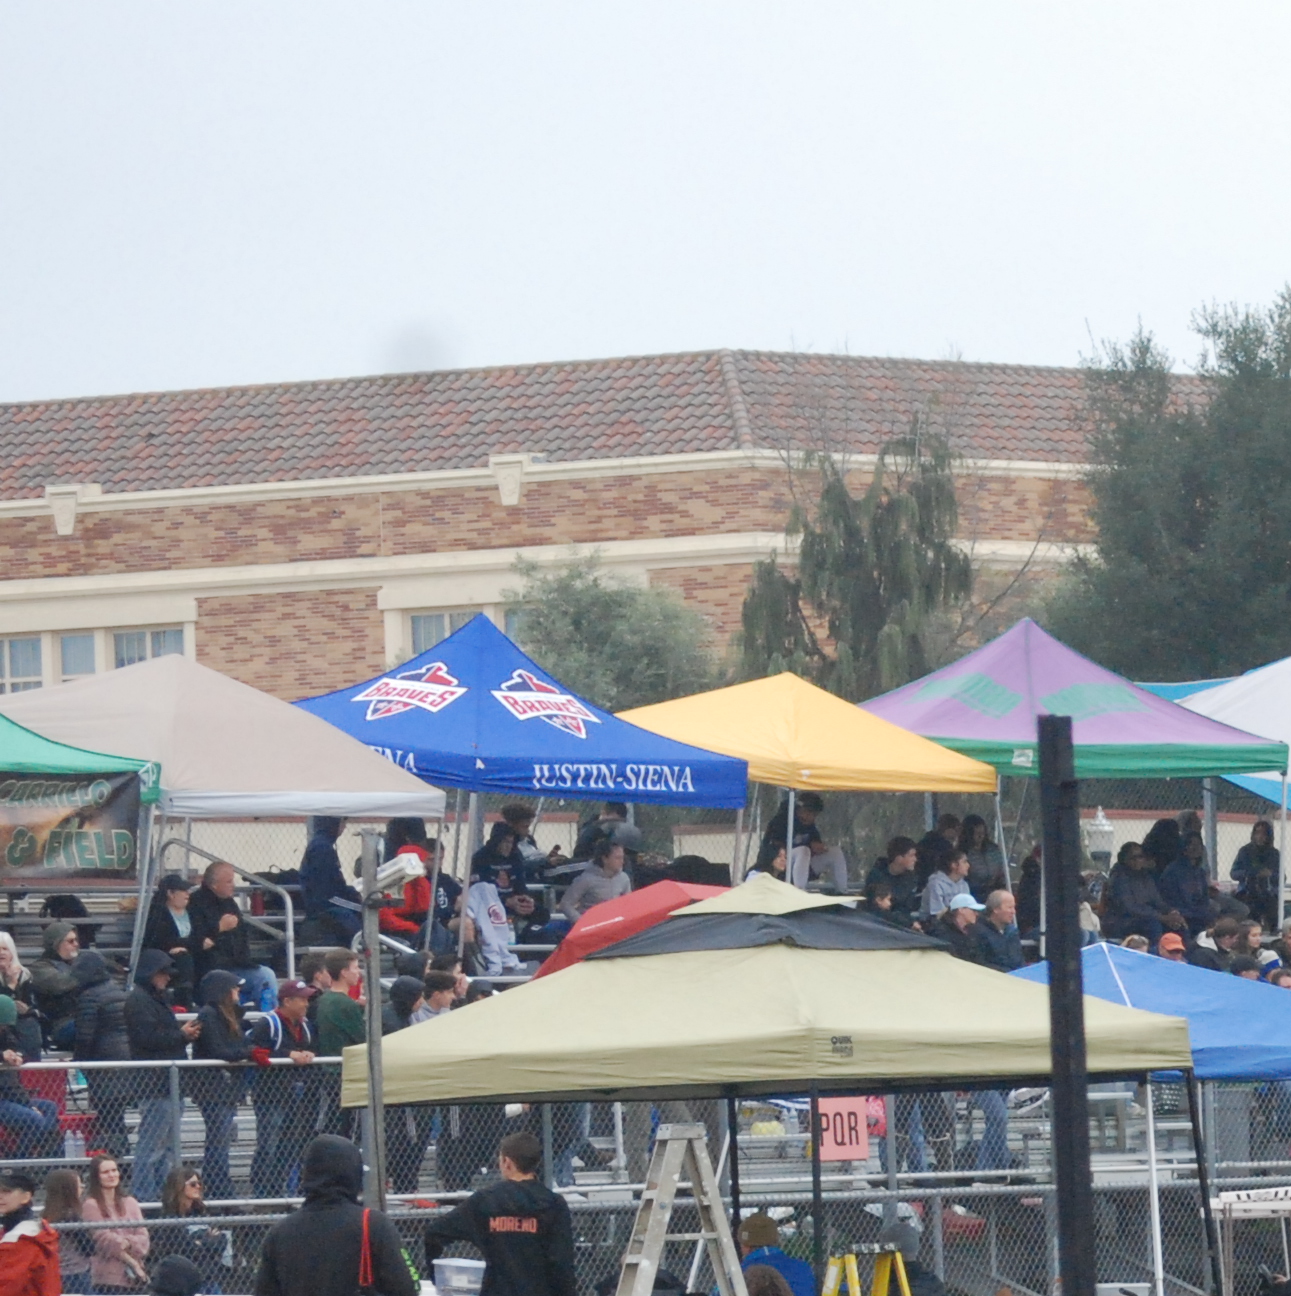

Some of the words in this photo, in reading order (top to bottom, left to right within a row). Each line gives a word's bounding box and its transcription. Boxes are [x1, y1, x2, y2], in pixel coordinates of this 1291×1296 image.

[362, 682, 458, 708] BRAVES
[502, 695, 592, 718] BRAVES
[532, 763, 695, 793] JUSTIN-SIENA
[6, 826, 37, 868] &
[44, 829, 134, 869] FIELD
[819, 1111, 860, 1148] PQR
[489, 1216, 538, 1233] MORENO
